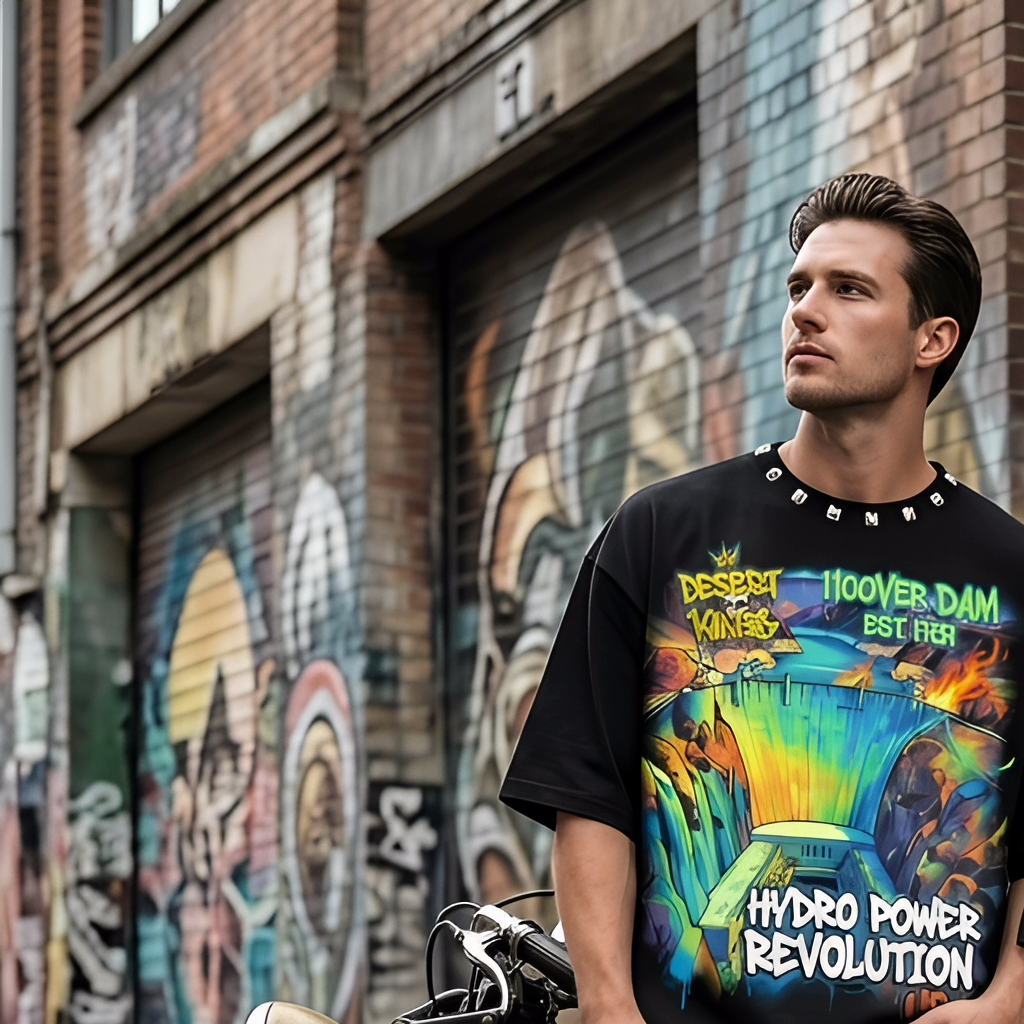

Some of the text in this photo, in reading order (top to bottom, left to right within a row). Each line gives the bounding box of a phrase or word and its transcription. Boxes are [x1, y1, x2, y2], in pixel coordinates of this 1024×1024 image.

[934, 582, 999, 624] DAM
[747, 886, 982, 941] HYDRO POWER
[743, 928, 974, 991] REVOLUTION
